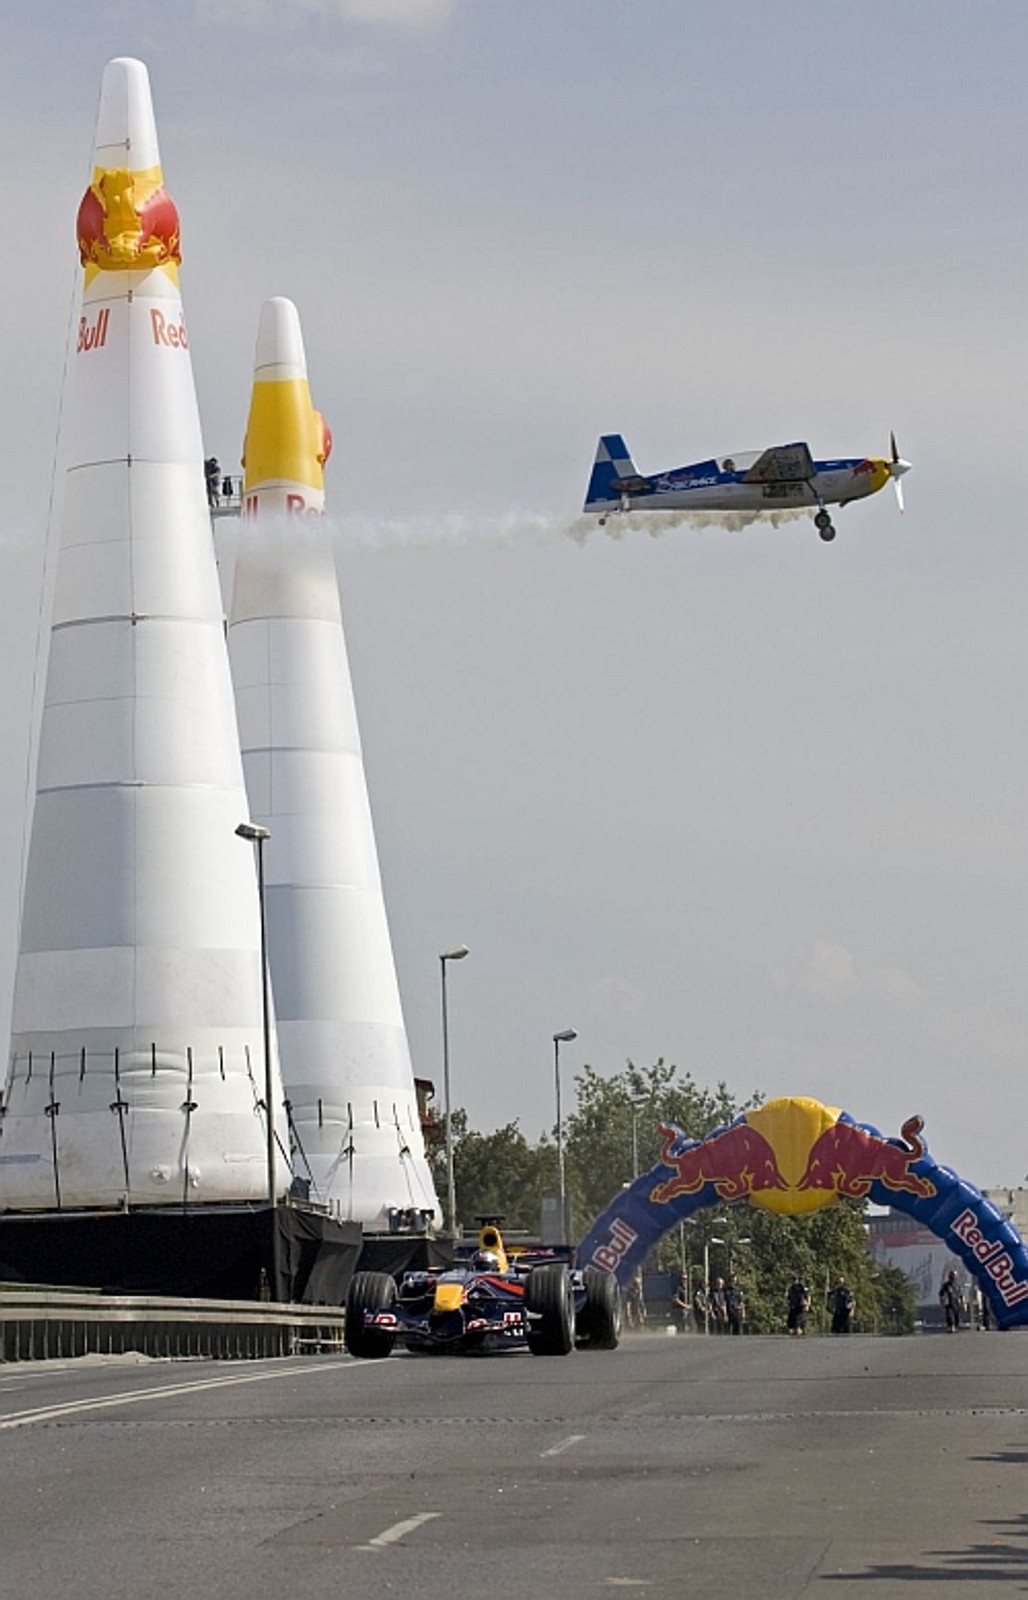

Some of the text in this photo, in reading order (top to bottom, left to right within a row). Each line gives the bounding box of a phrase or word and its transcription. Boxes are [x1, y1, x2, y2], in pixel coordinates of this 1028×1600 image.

[592, 1217, 638, 1272] Bull
[951, 1208, 1028, 1307] Red Bull
